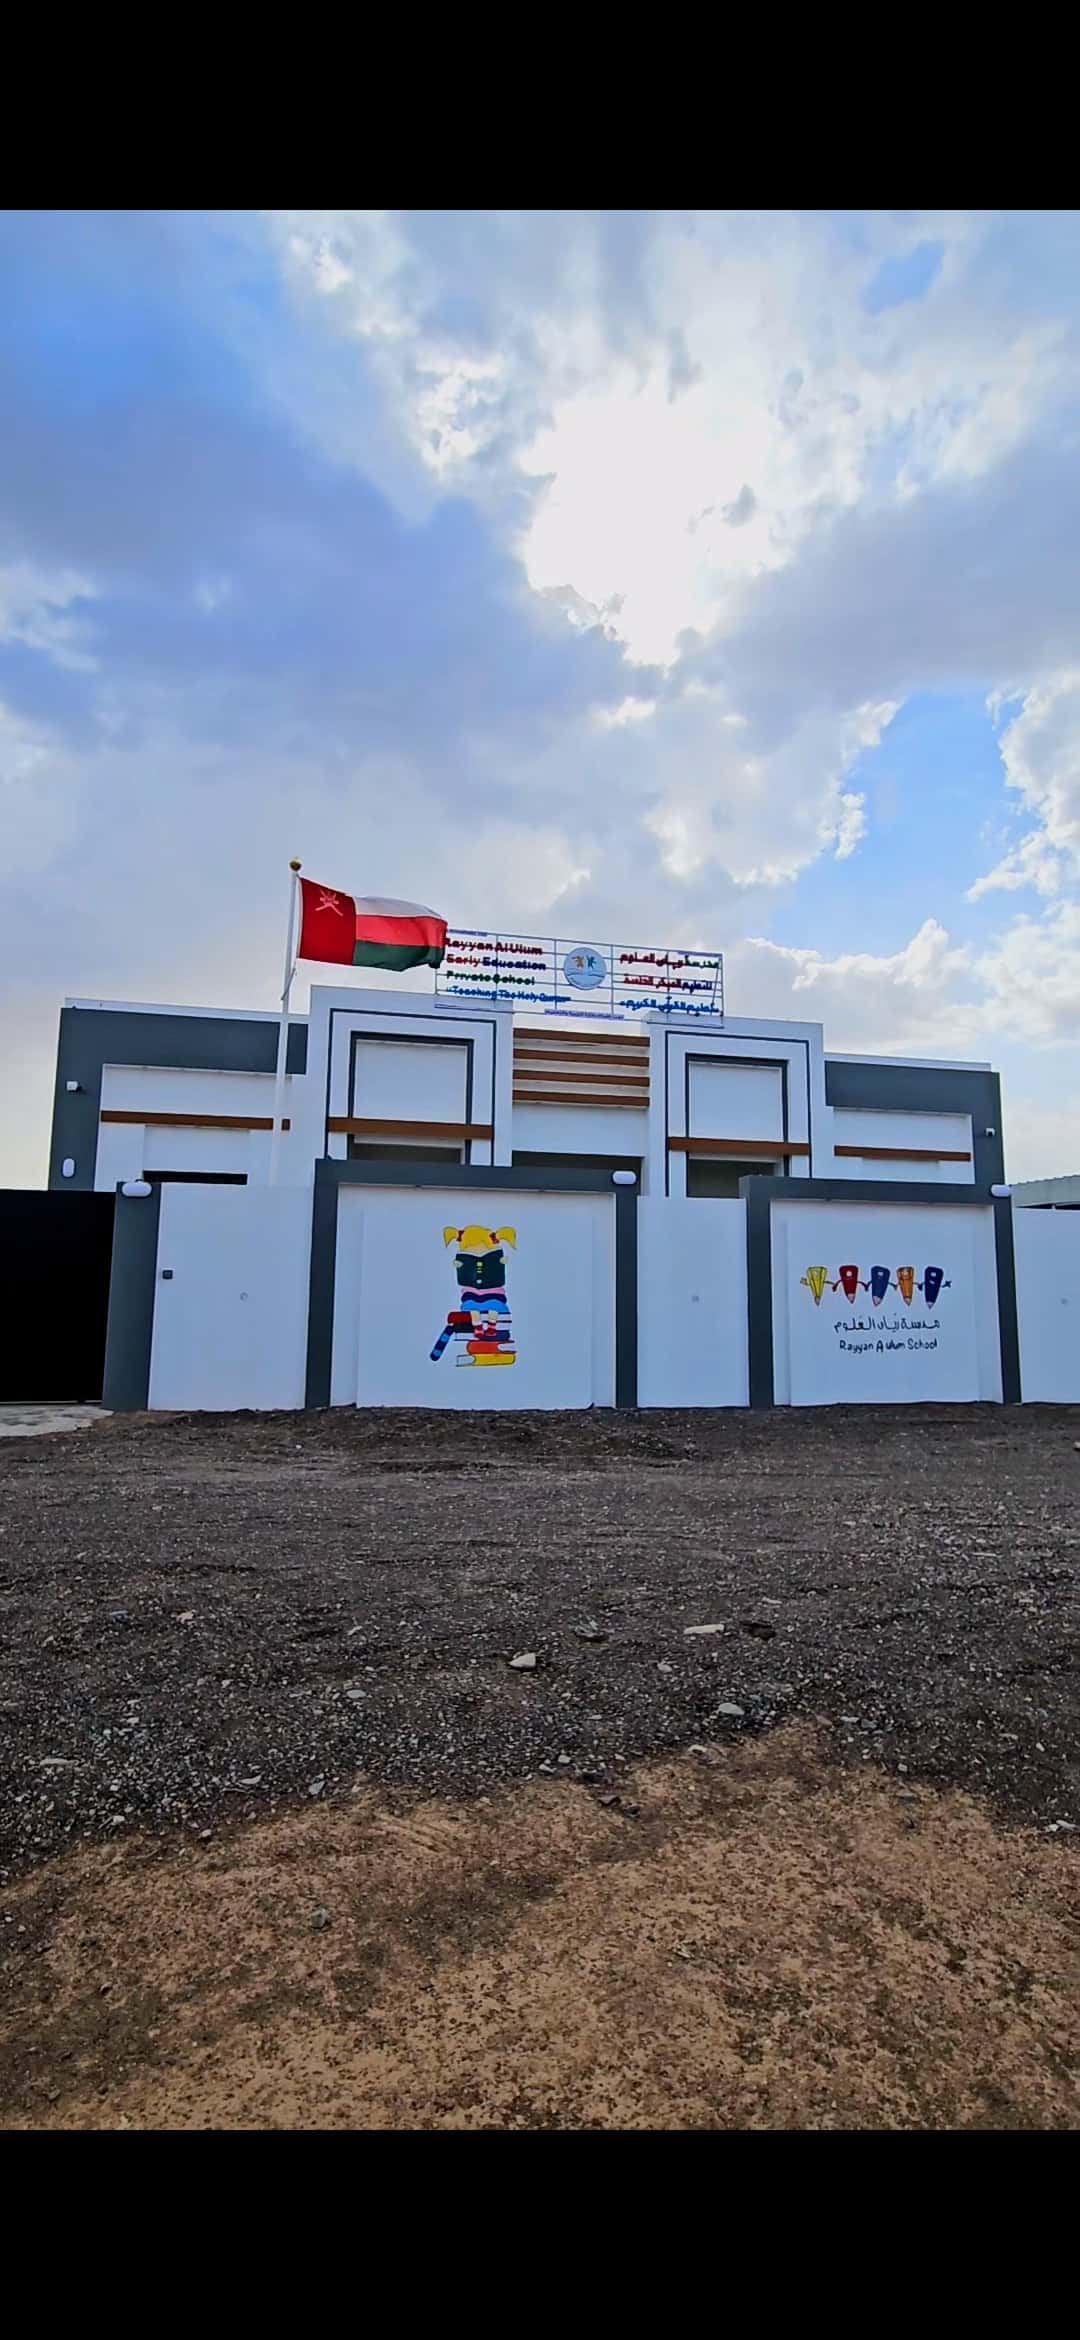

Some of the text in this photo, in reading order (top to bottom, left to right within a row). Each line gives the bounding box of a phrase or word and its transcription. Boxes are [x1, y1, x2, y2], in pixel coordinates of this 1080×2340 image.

[444, 938, 493, 951] Rayyan
[447, 954, 546, 970] Early Education
[620, 952, 655, 964] العلوم
[685, 955, 720, 968] مدرسة
[447, 970, 535, 985] Private School
[840, 1340, 874, 1354] Rayyan
[907, 1338, 937, 1350] School
